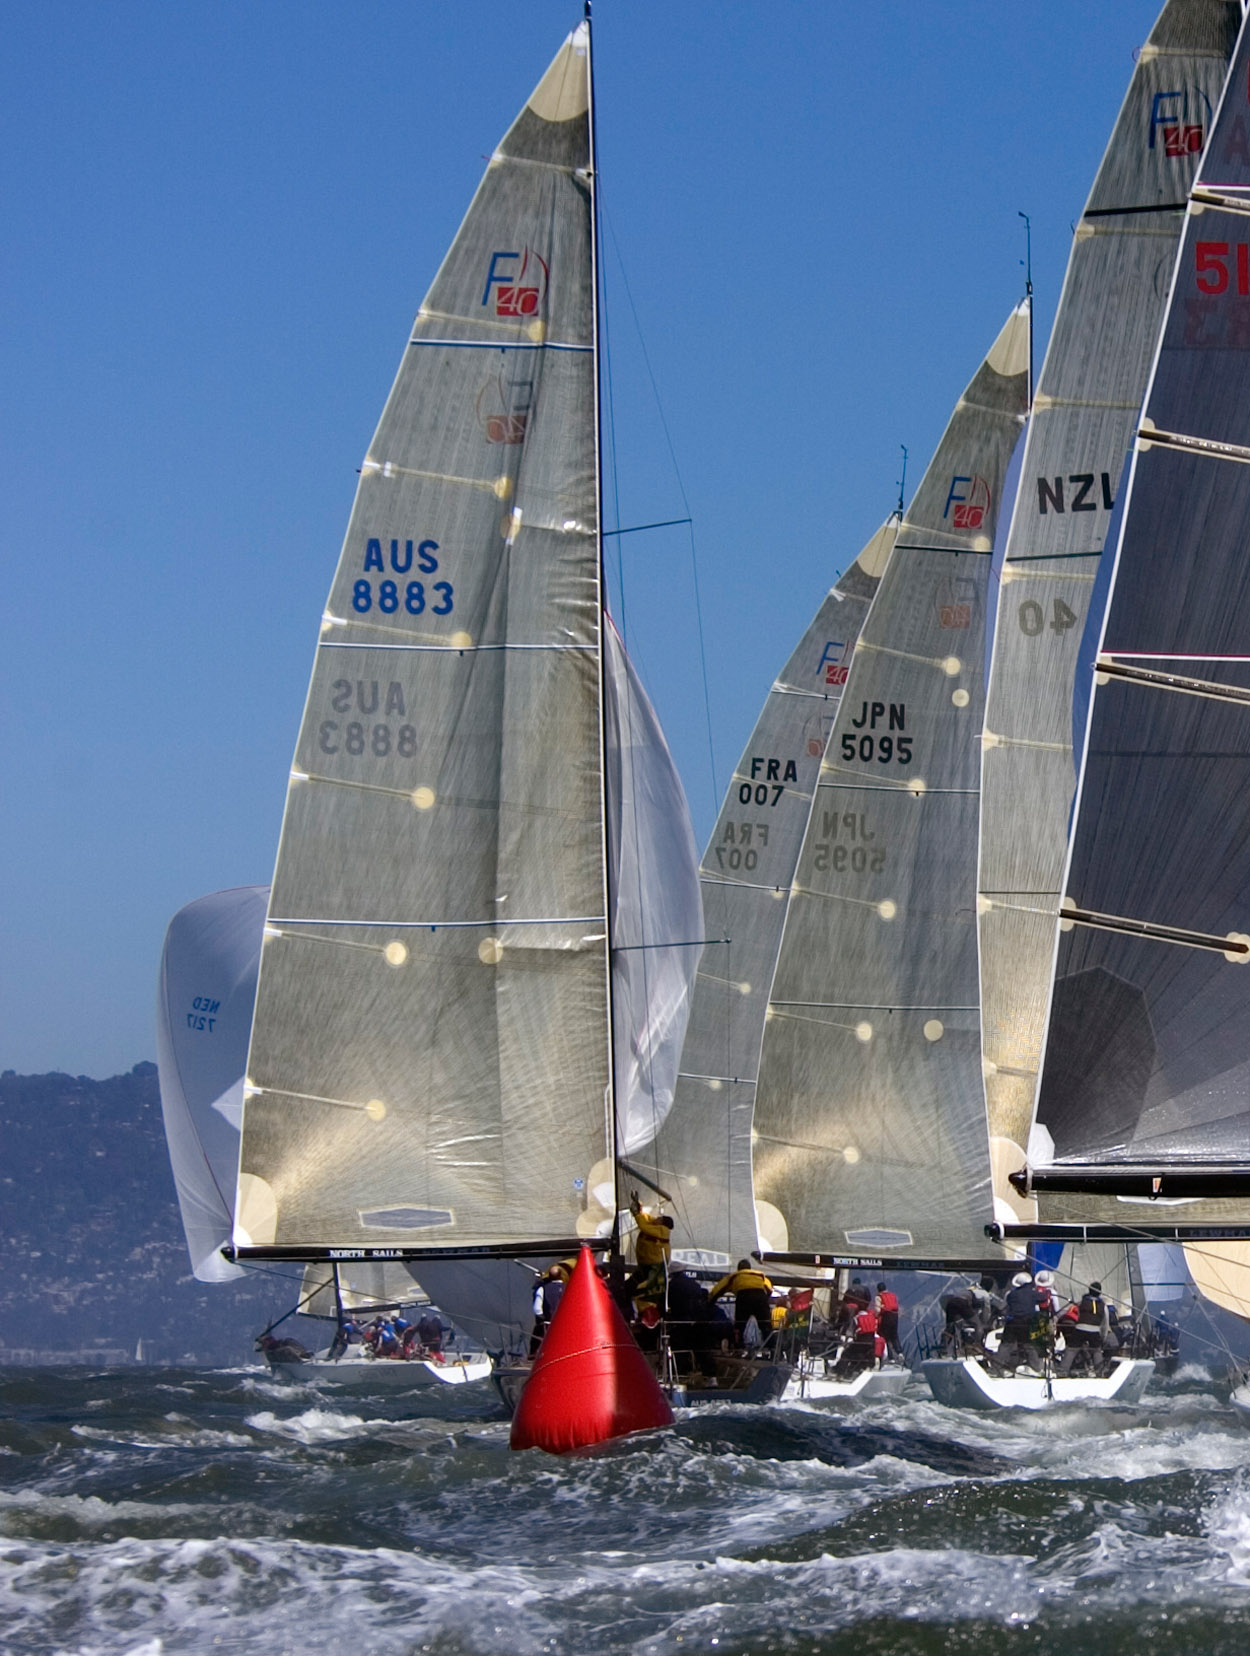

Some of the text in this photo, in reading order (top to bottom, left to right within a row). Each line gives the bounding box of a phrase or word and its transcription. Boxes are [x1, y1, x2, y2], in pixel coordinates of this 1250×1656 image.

[497, 286, 539, 316] 40
[363, 538, 440, 574] AUS
[352, 578, 455, 616] 8883
[852, 701, 906, 731] JPN
[841, 734, 913, 765] 5095
[750, 757, 798, 783] FRA
[738, 783, 785, 807] 007
[329, 1249, 403, 1258] NORTH SAILS
[833, 1257, 882, 1267] NORTH SAILS
